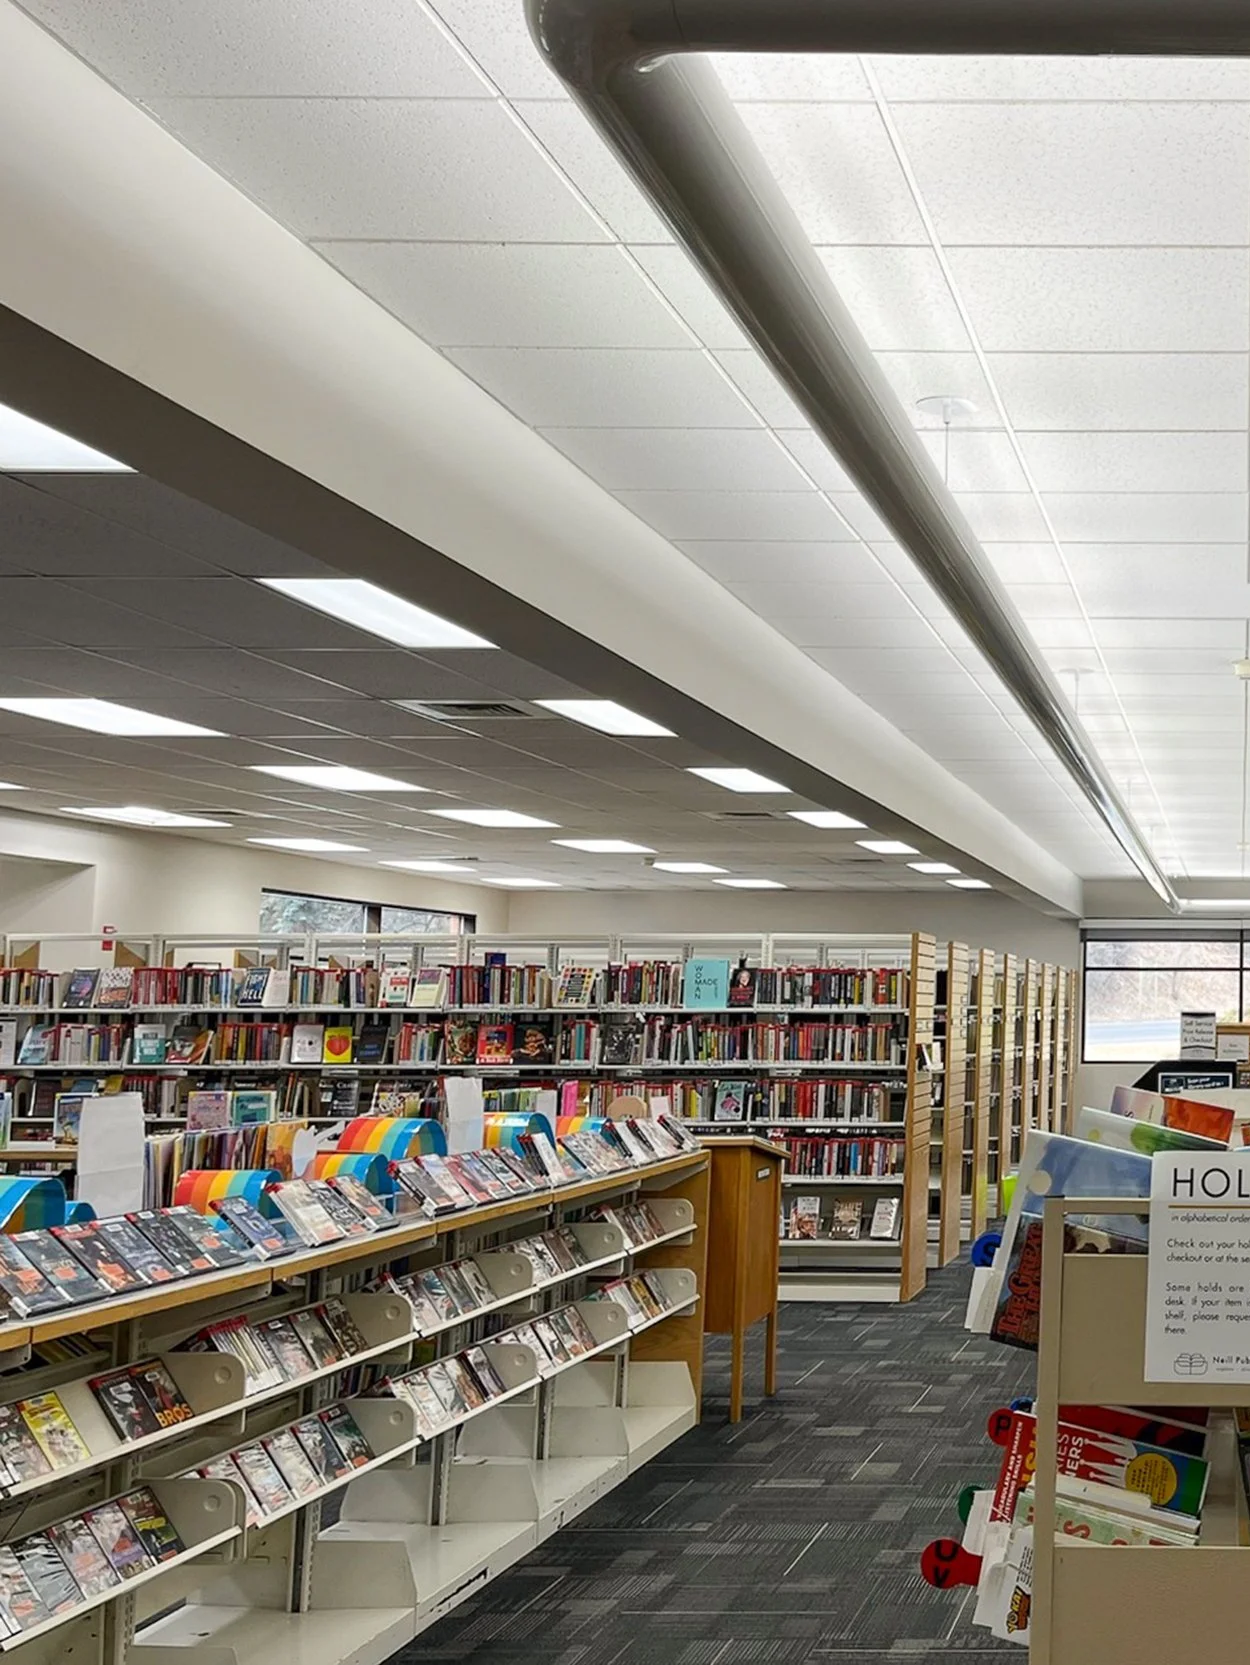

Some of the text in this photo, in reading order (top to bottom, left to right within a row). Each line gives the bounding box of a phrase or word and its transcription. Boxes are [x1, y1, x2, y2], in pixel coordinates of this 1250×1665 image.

[1180, 1213, 1229, 1224] alphabetical
[1166, 1238, 1195, 1248] Check
[1198, 1240, 1214, 1249] out
[1216, 1242, 1236, 1251] your
[1166, 1252, 1203, 1263] checkout
[1203, 1255, 1214, 1263] or
[1215, 1254, 1225, 1263] at
[1226, 1253, 1239, 1263] the
[1165, 1282, 1191, 1292] Some
[1197, 1282, 1223, 1293] holds
[1228, 1284, 1245, 1293] are
[1200, 1299, 1221, 1309] your
[1224, 1297, 1242, 1307] item
[1164, 1309, 1187, 1322] shelf,
[1192, 1311, 1220, 1323] please
[1164, 1323, 1187, 1335] there.
[1212, 1355, 1234, 1364] Neill
[155, 1402, 194, 1428] BROS
[994, 1414, 1012, 1437] P
[1007, 1454, 1016, 1471] AND
[933, 1564, 951, 1589] V
